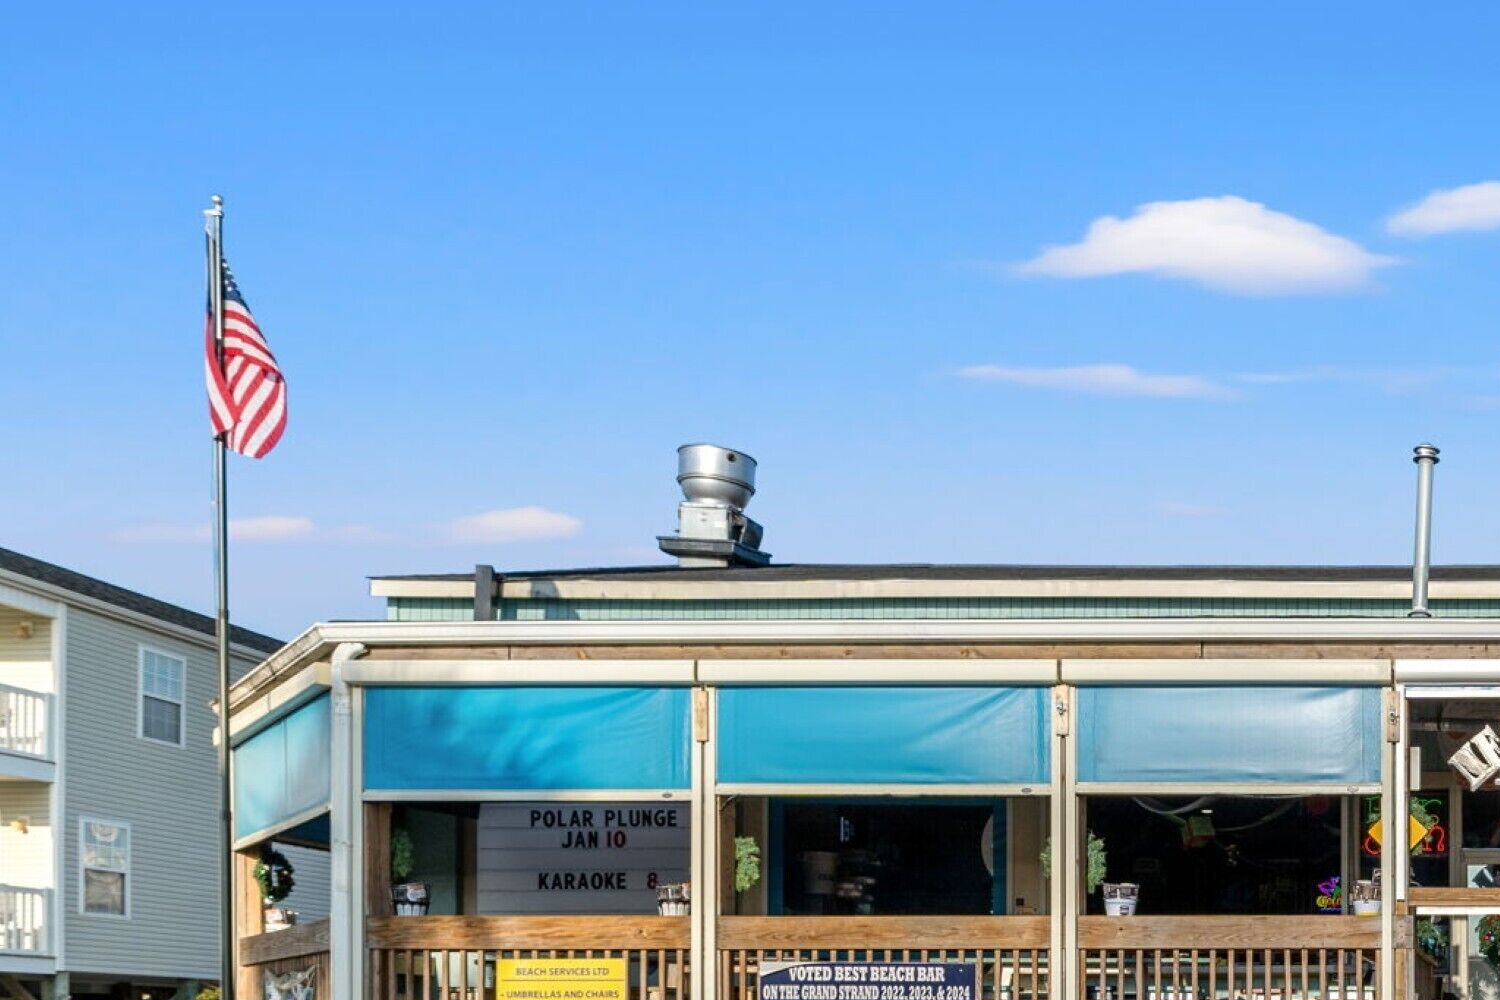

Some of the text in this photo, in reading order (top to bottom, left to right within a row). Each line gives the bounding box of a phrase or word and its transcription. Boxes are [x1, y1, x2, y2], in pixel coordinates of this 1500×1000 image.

[530, 810, 677, 827] POLAR PLUNGE
[562, 831, 626, 848] JAN 10
[538, 873, 658, 890] KARAOKE 8
[516, 968, 609, 976] BEACH SERVICES LTD
[788, 966, 945, 982] VOTED BEST BEACH BAR
[506, 990, 619, 998] UMBRELLAS AND CHAIRS
[763, 986, 779, 1000] ON
[780, 986, 799, 1000] THE
[802, 986, 837, 1000] GRAND
[838, 986, 880, 1000] STRAND
[936, 986, 945, 1000] &
[946, 986, 970, 1000] 2024
